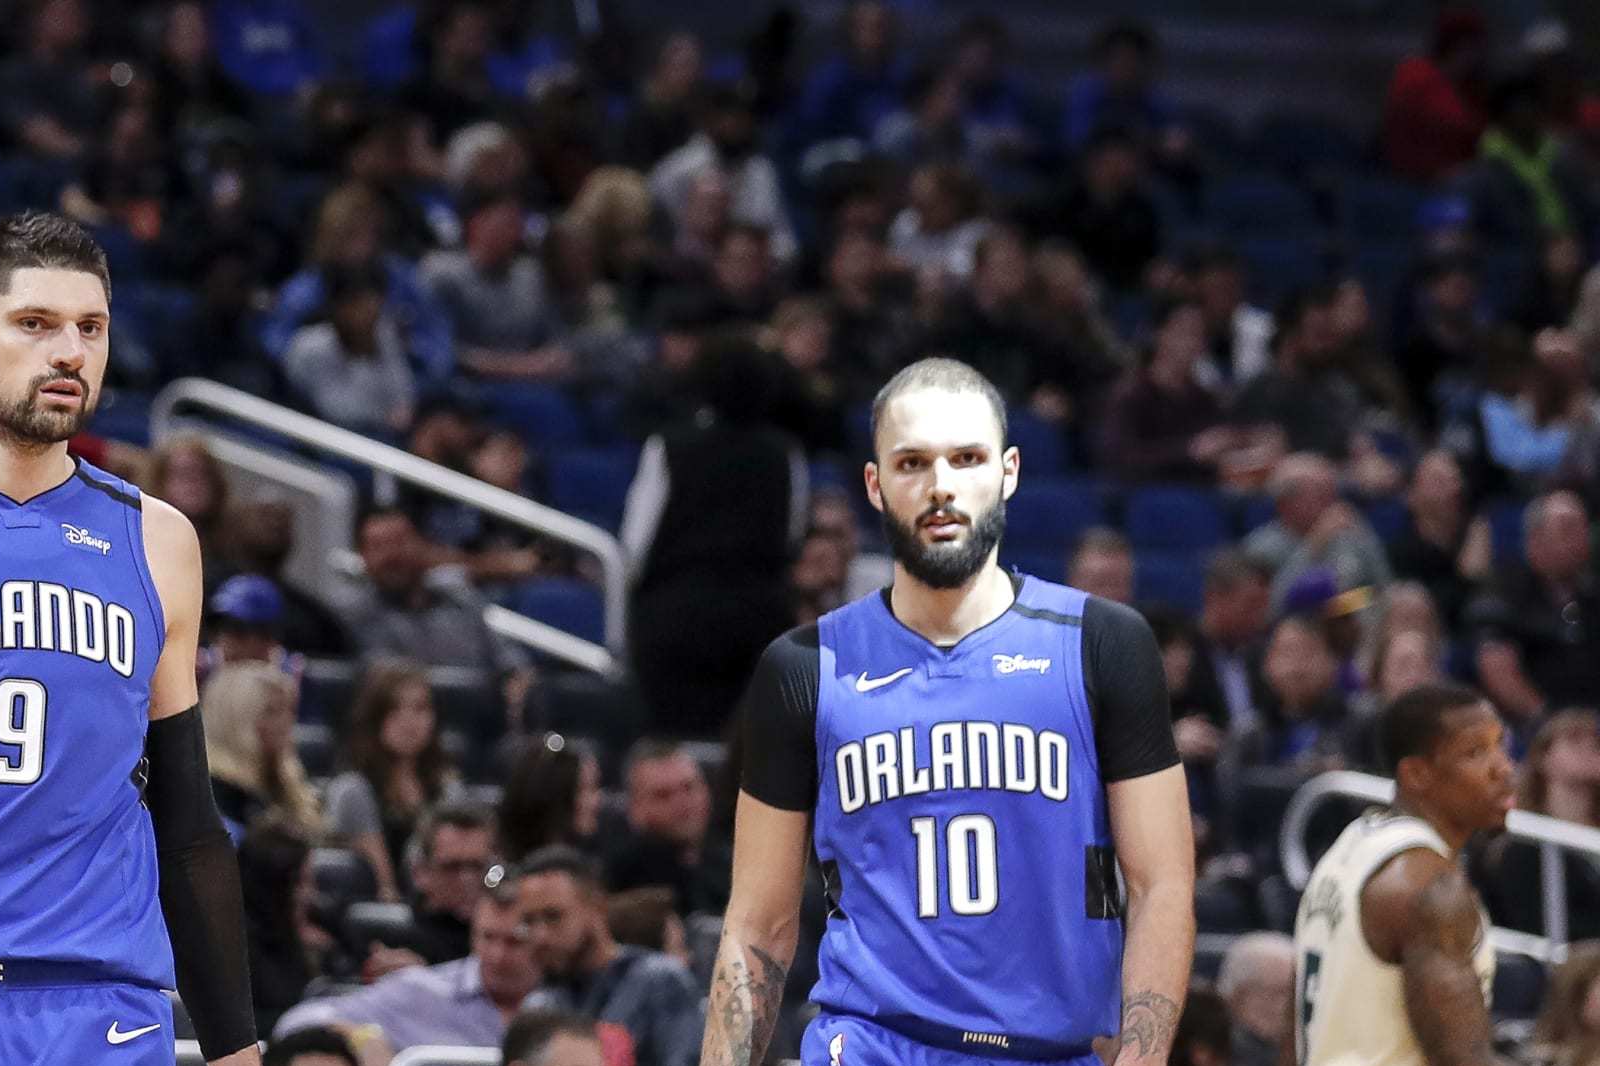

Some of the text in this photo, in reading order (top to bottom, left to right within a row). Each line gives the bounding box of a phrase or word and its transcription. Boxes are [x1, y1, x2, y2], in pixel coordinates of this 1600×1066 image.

[61, 523, 111, 555] Disney
[835, 719, 1069, 815] ORLANDO
[910, 813, 999, 919] 10
